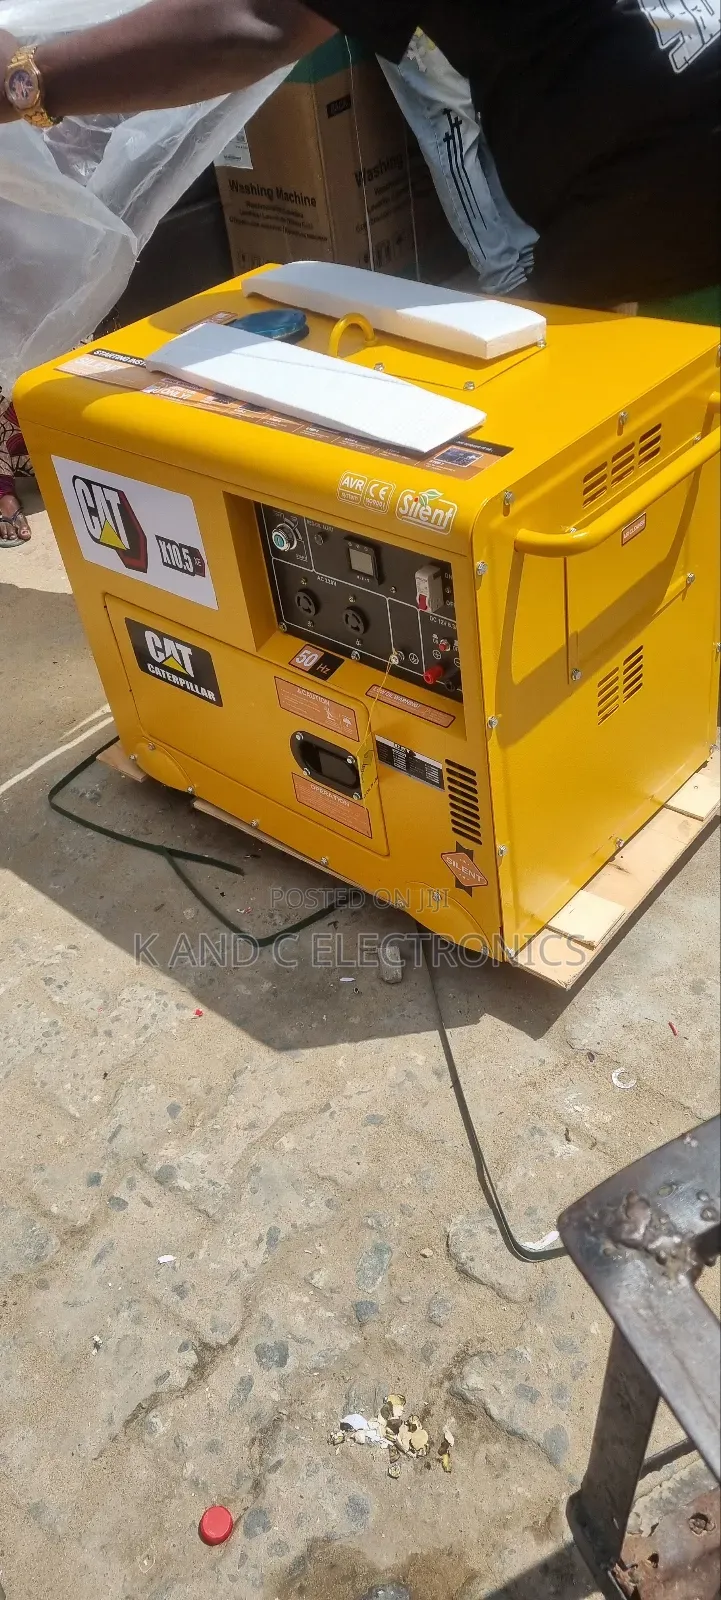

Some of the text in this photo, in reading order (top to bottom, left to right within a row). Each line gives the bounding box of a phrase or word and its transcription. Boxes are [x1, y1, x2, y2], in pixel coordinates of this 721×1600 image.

[354, 155, 404, 188] Washing
[228, 179, 317, 207] Washing Machine
[93, 349, 128, 364] STARTING
[341, 476, 365, 491] AVR
[73, 476, 131, 550] CAT
[398, 493, 454, 529] Silent
[143, 629, 195, 678] CAT
[295, 649, 331, 675] 50 Hz
[146, 662, 217, 702] CATERPILLAR
[310, 784, 350, 807] OPERATION
[446, 856, 483, 882] SILENT
